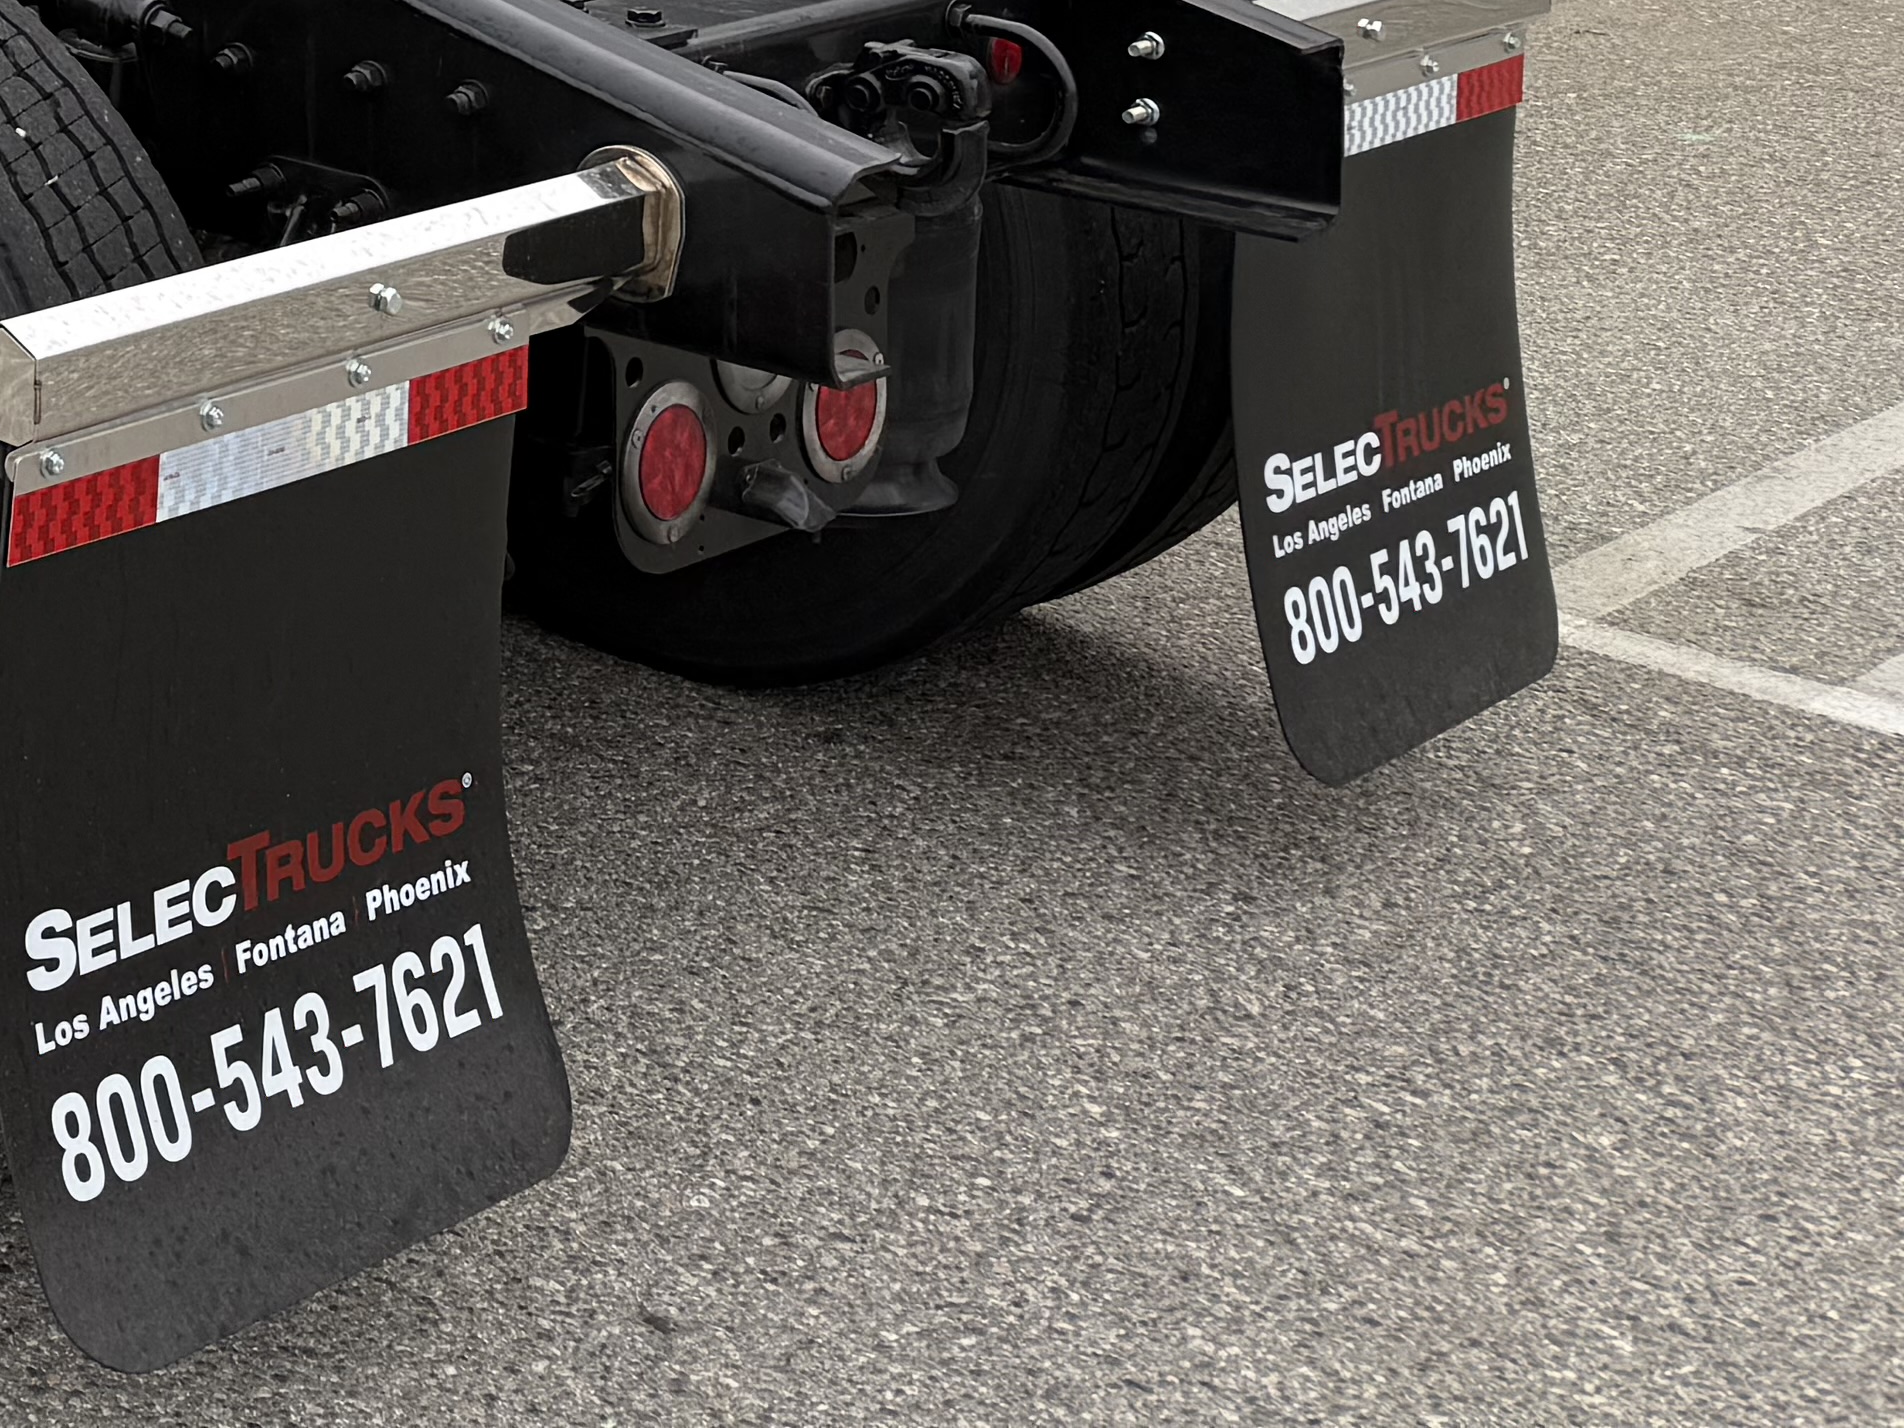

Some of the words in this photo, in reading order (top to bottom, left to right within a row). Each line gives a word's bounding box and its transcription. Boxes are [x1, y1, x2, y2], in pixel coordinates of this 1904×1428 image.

[1273, 531, 1304, 558] Los
[1307, 501, 1372, 546] Angeles
[1382, 472, 1444, 513] Fontana
[1453, 441, 1512, 483] Phoenix
[1284, 490, 1529, 665] 800-543-7621
[35, 1013, 90, 1055] Los
[99, 964, 215, 1032] Angeles
[236, 911, 347, 974] Fontana
[366, 857, 472, 922] Phoenix
[52, 923, 504, 1202] 800-543-7621
